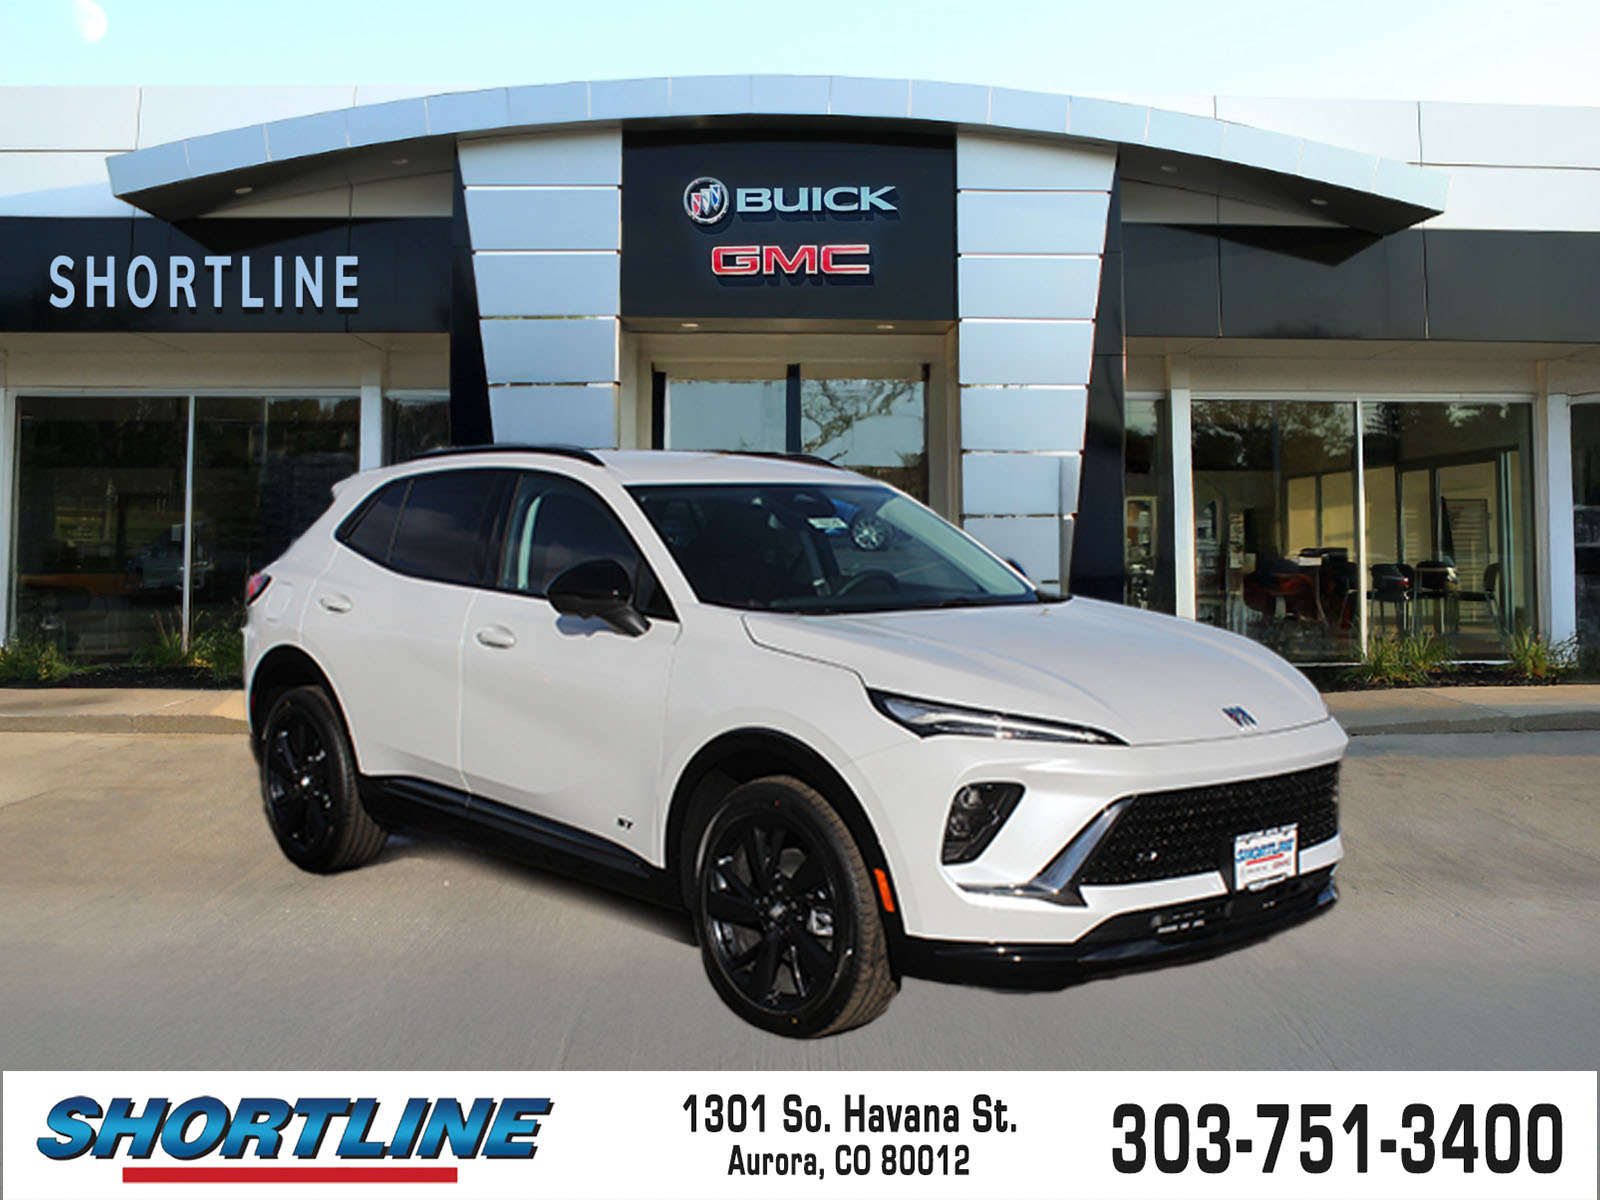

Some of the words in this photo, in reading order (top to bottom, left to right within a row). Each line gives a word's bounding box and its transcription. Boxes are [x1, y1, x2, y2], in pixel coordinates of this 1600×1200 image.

[736, 186, 897, 212] BUICK
[711, 244, 870, 275] GMC
[49, 255, 359, 309] SHORTLINE
